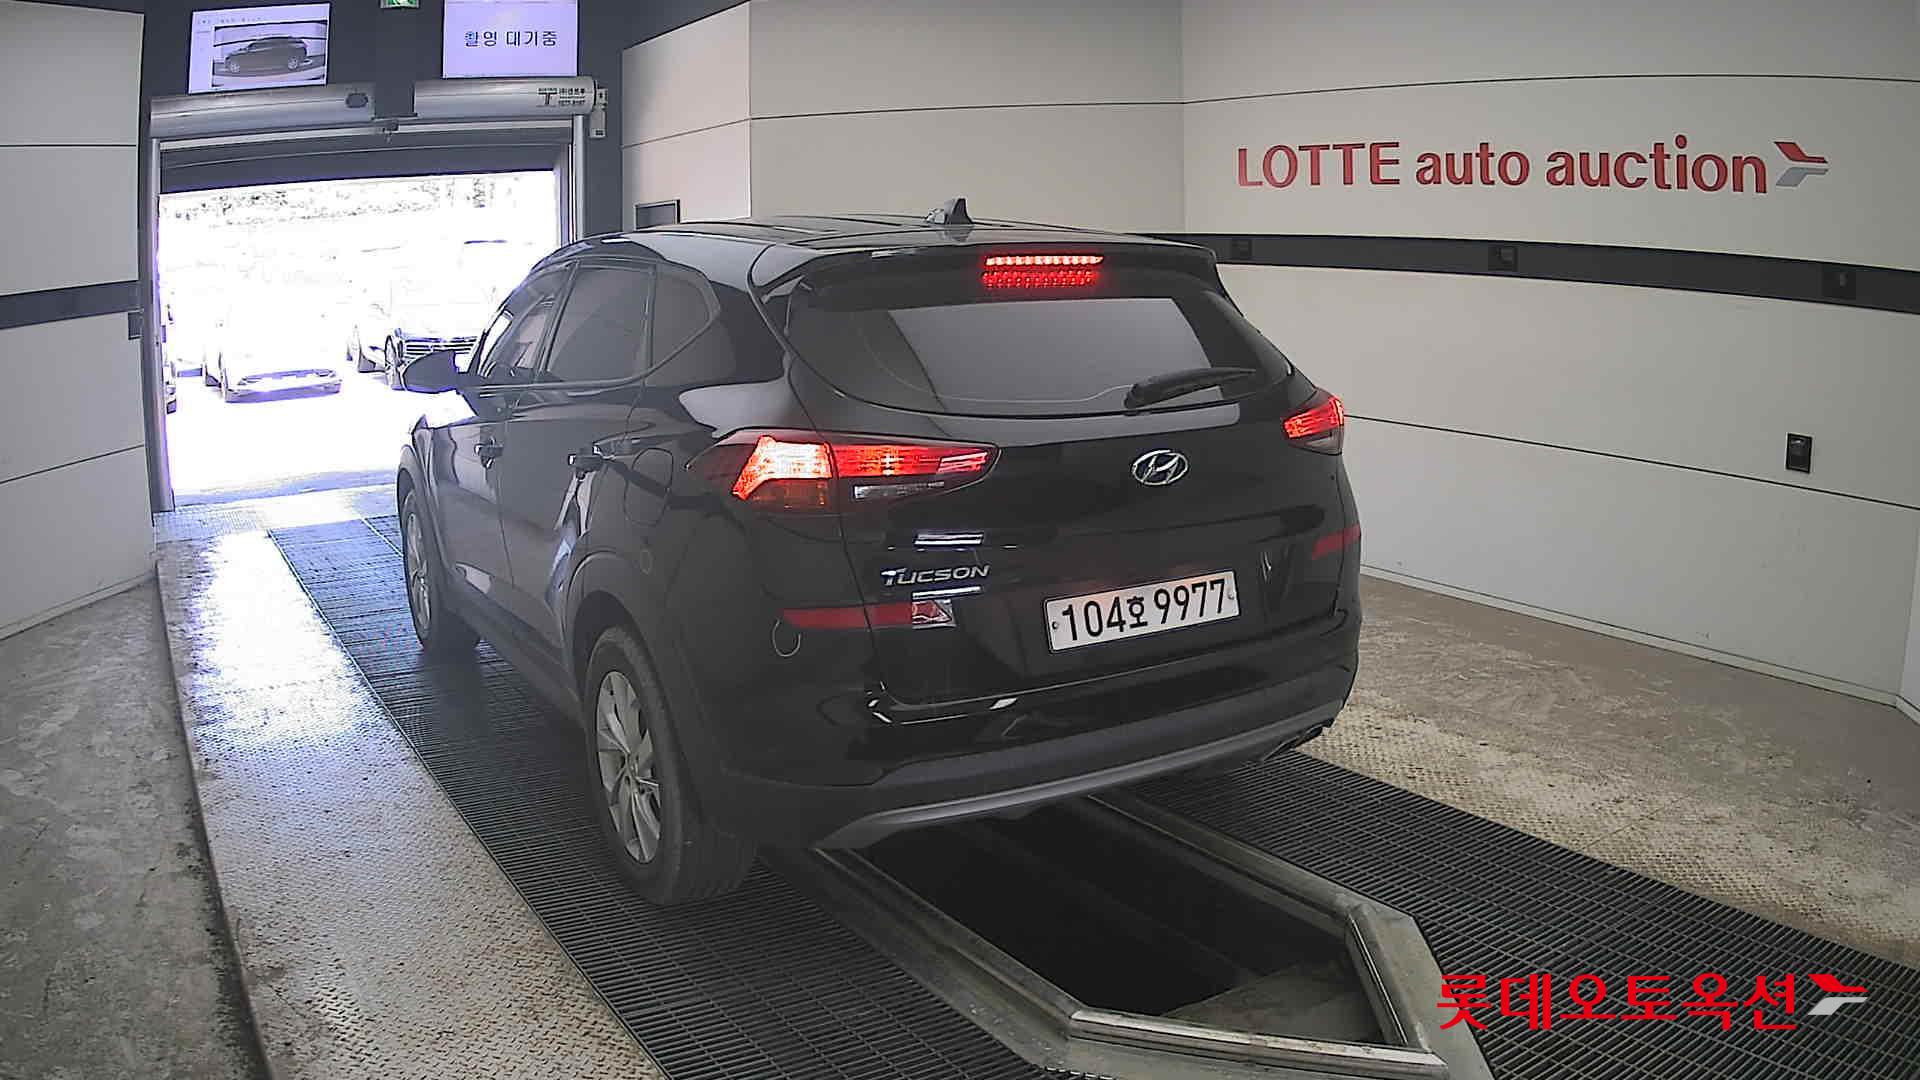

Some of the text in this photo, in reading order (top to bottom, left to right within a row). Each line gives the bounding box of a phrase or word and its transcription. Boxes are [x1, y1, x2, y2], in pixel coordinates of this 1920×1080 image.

[506, 30, 558, 47] 대기중
[1237, 134, 1768, 194] LOTTE auto auction
[880, 564, 990, 587] TUCSON
